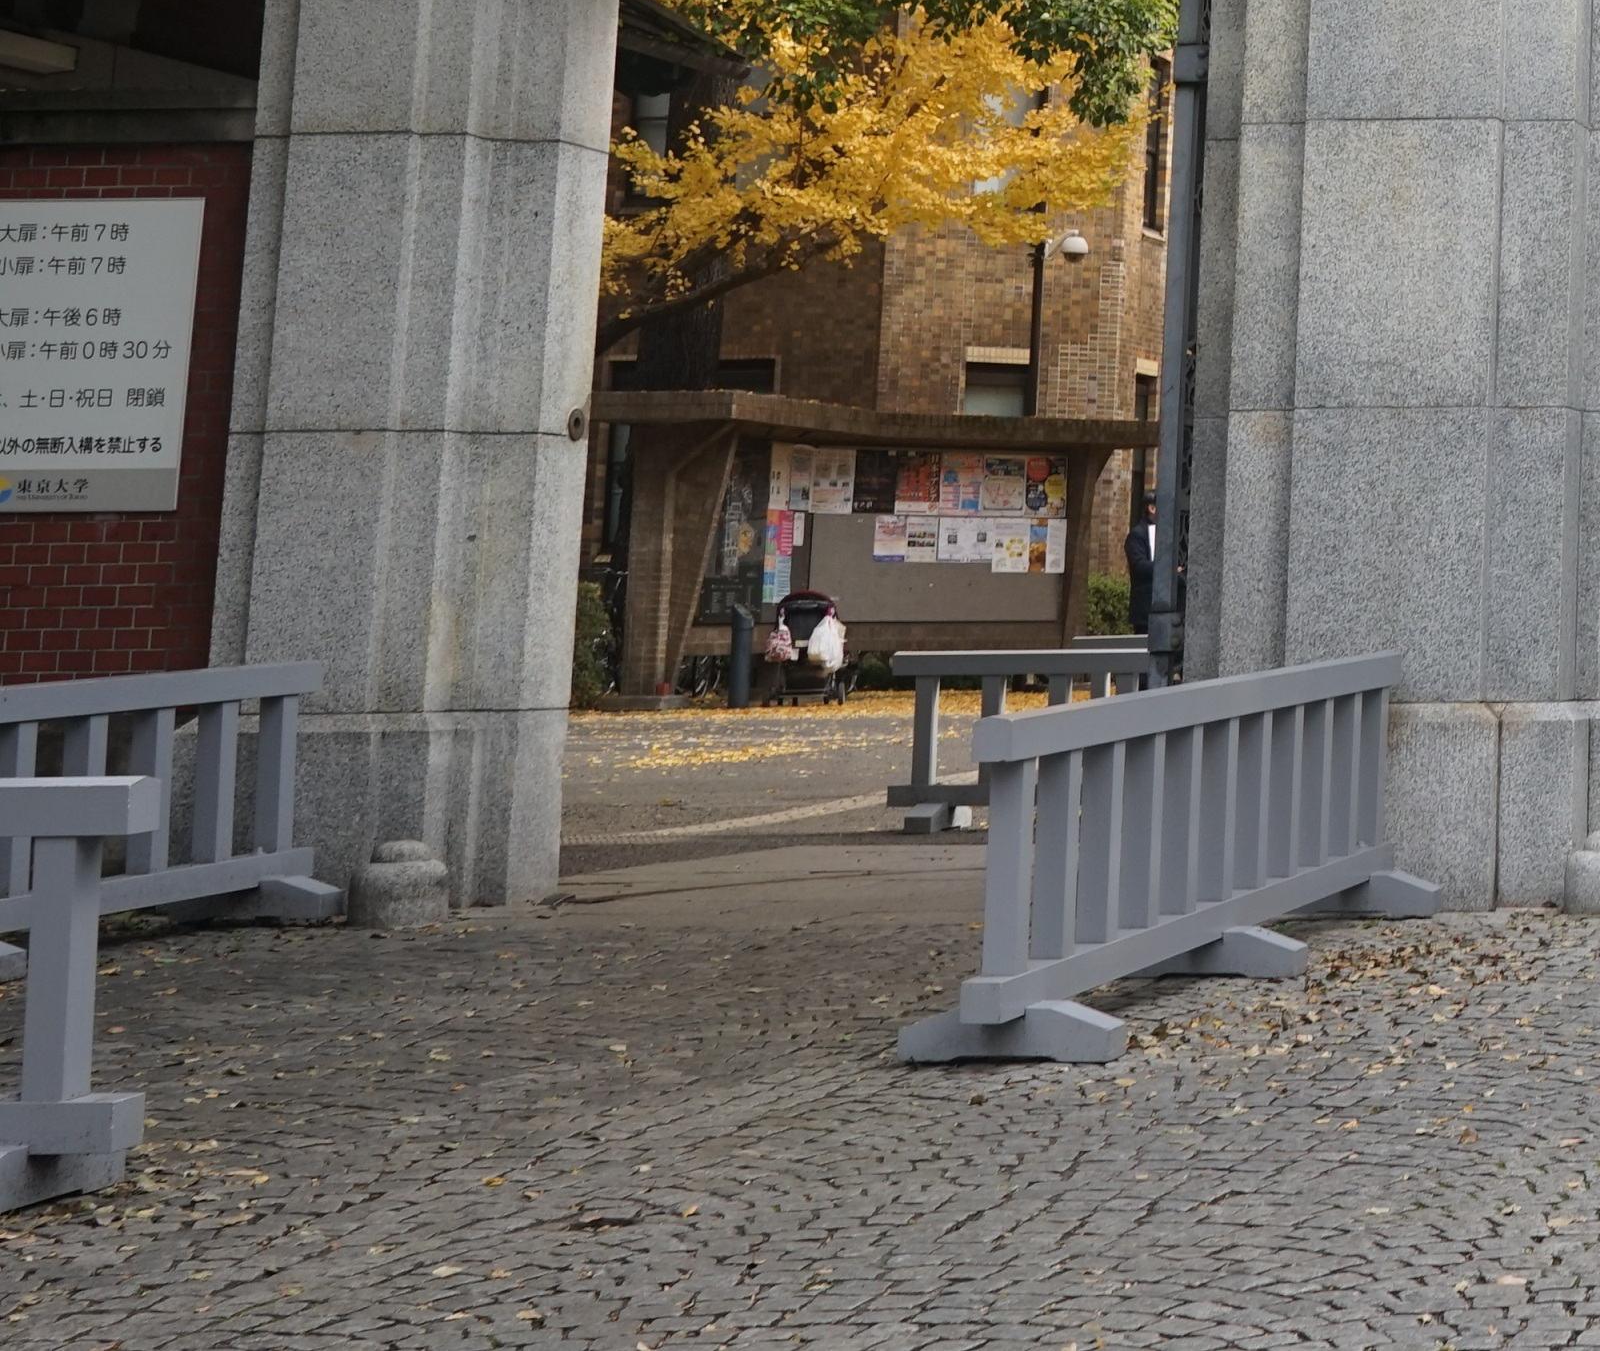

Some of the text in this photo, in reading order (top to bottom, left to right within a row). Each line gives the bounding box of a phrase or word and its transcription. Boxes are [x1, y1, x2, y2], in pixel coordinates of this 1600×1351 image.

[0, 340, 172, 360] 扉：午前0時30分
[126, 387, 165, 407] 閉鎖
[17, 478, 89, 493] 東京大学
